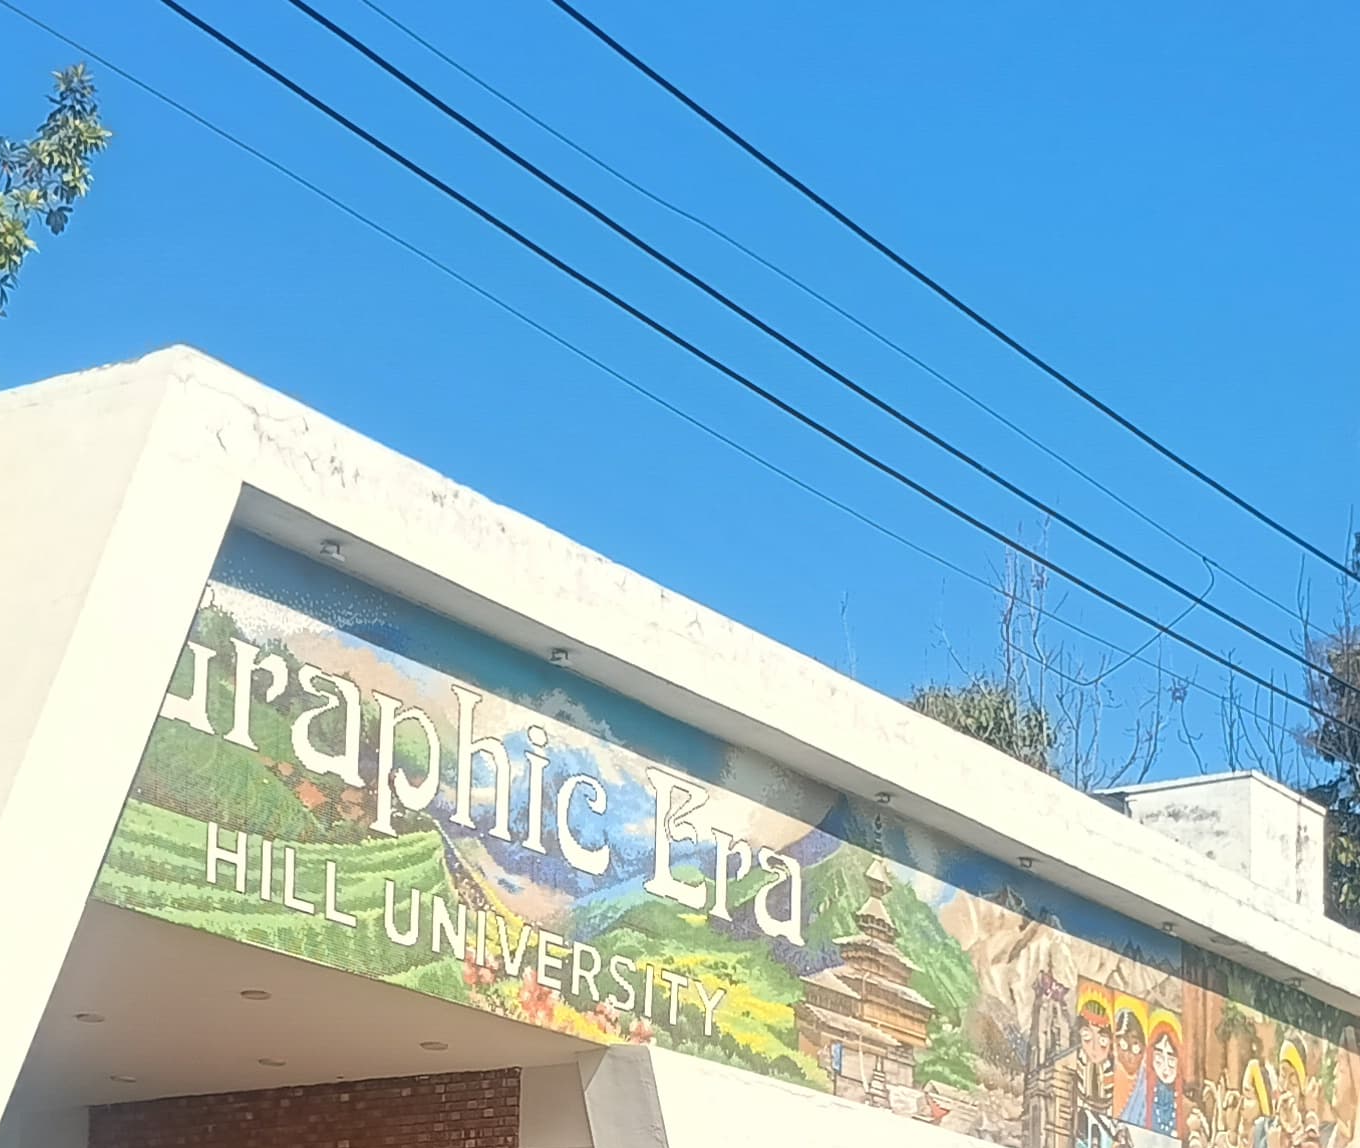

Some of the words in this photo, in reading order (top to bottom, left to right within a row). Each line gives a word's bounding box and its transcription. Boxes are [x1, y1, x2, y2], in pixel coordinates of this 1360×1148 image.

[204, 821, 358, 929] HILL
[383, 877, 728, 1038] UNIVERSITY
[644, 765, 806, 948] Era
